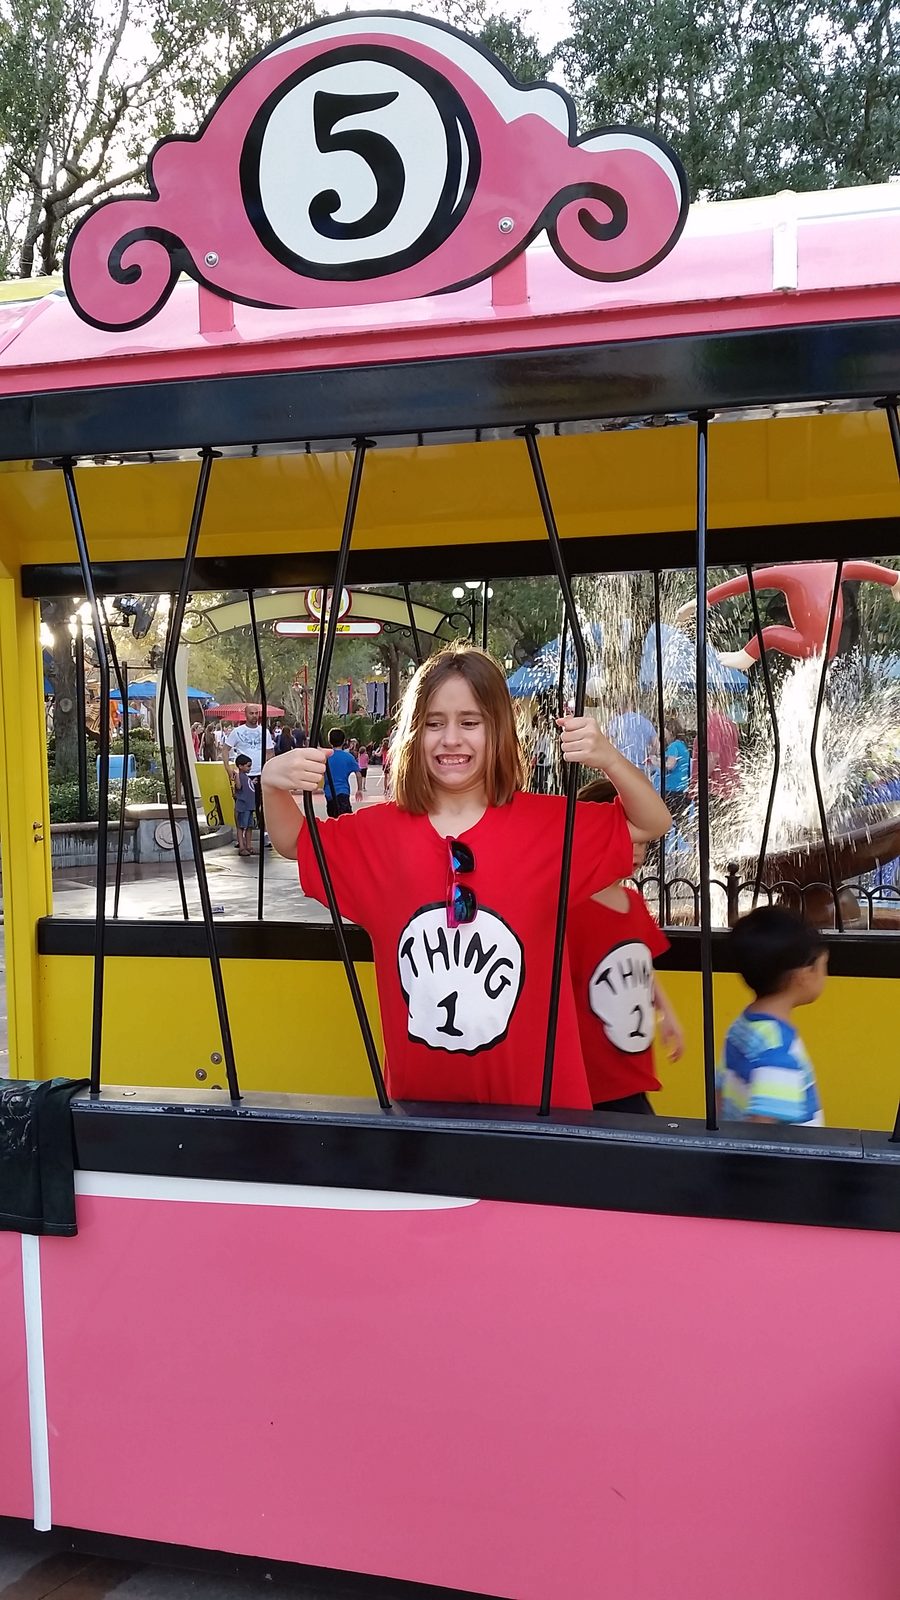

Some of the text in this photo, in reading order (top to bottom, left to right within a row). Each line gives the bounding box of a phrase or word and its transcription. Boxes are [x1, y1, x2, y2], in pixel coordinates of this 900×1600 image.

[309, 91, 406, 240] 5
[401, 927, 514, 999] THING
[437, 991, 464, 1036] 1
